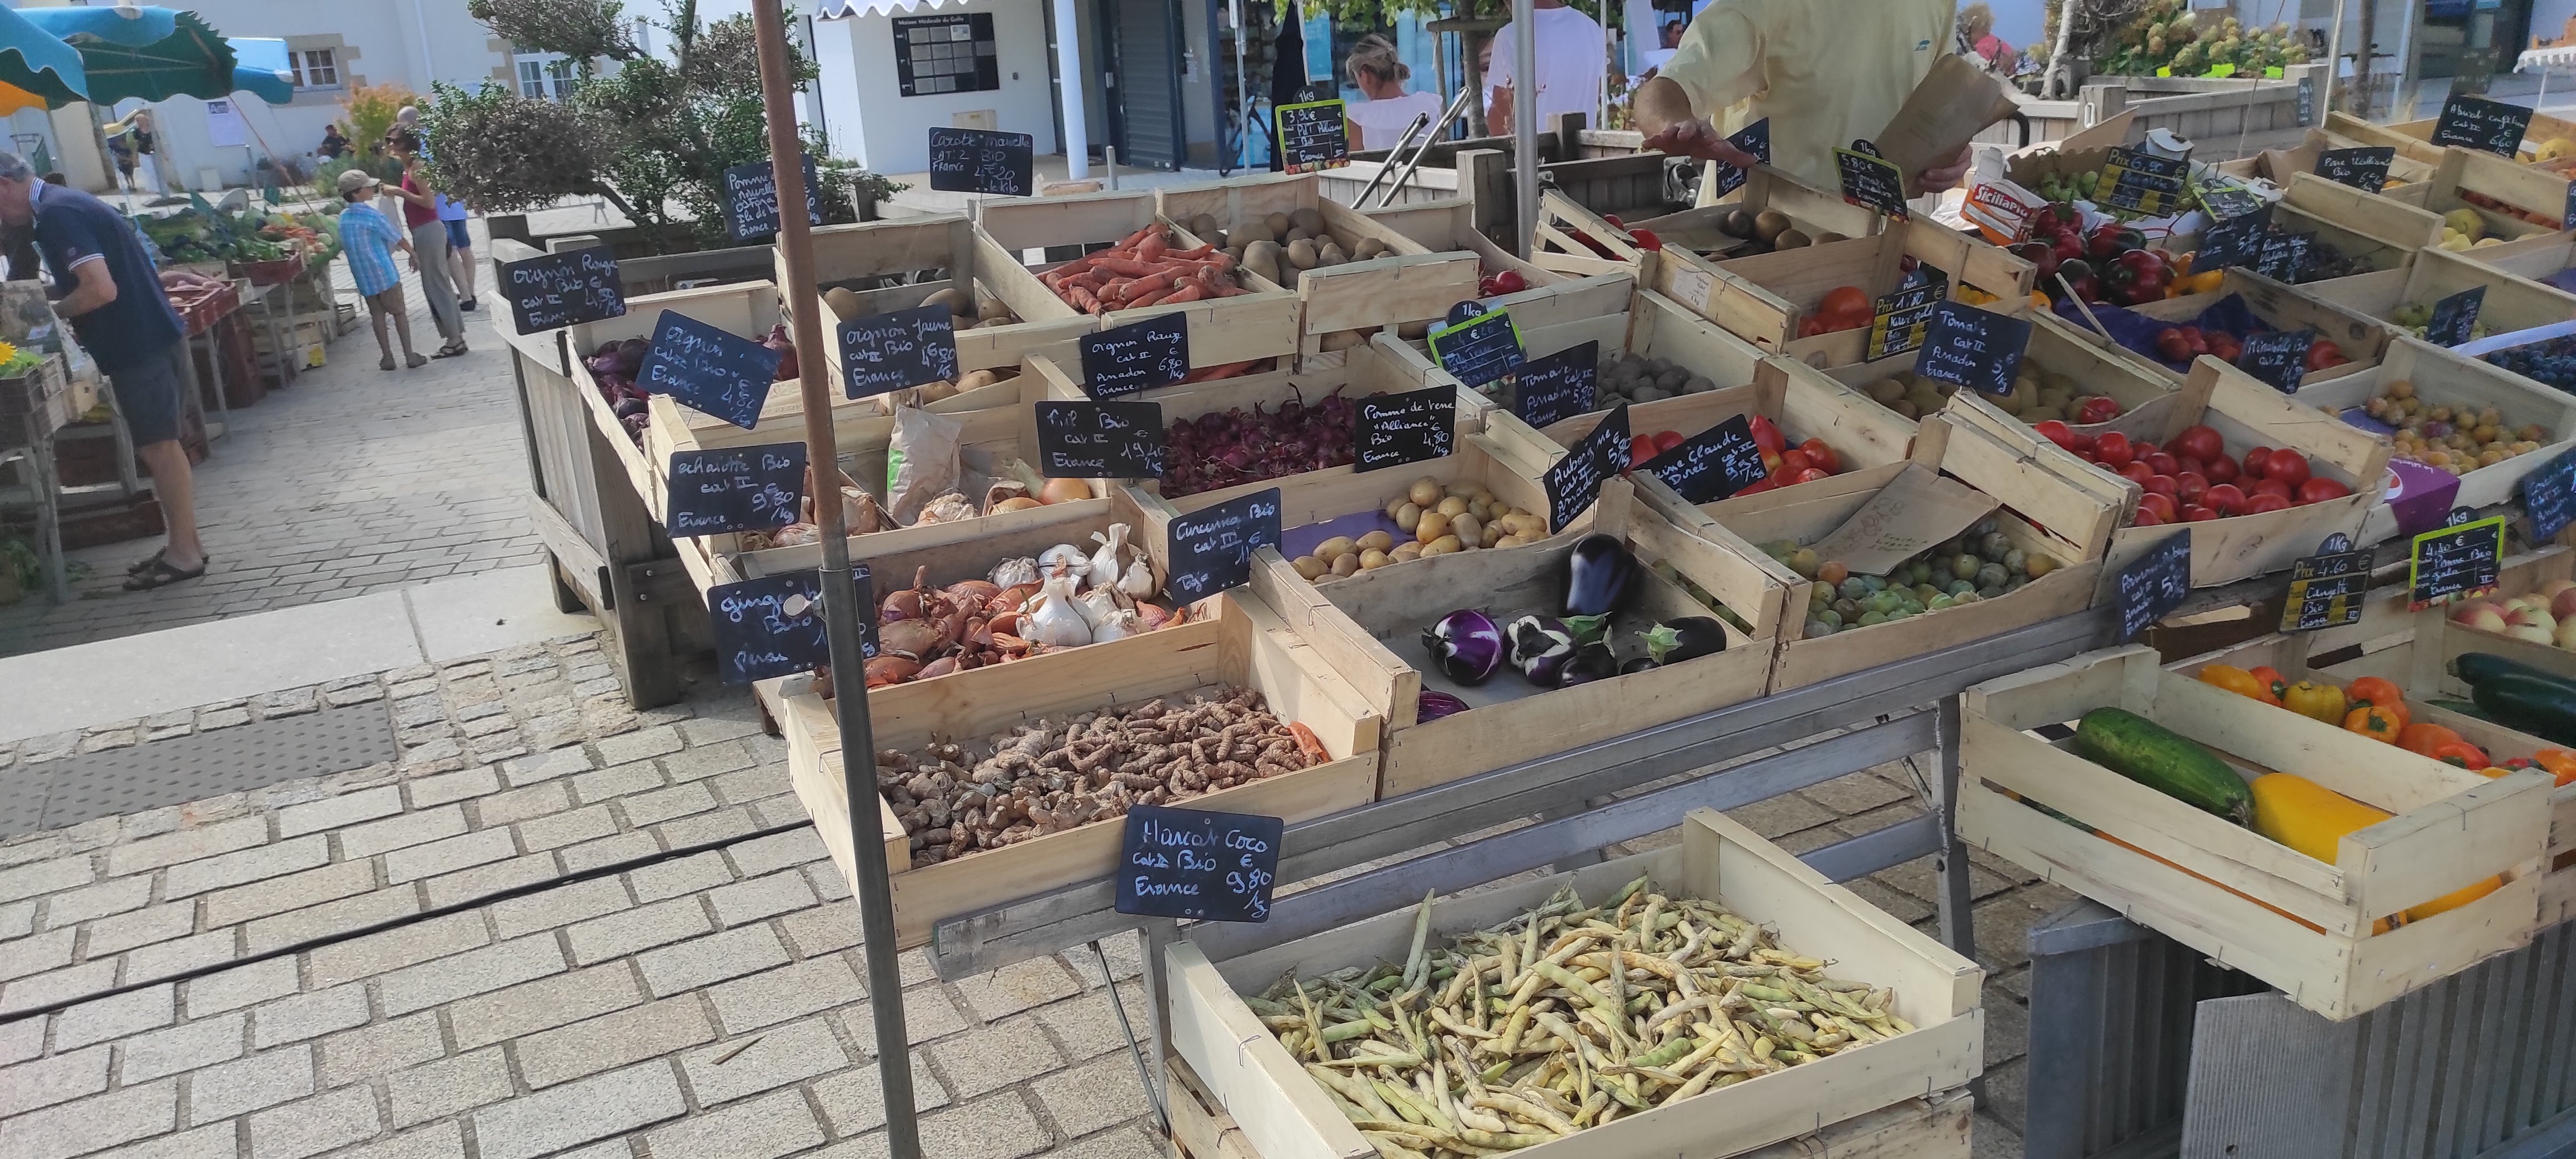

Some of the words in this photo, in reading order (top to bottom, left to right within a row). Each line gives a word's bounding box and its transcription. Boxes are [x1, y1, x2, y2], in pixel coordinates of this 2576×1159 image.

[1299, 89, 1315, 103] 1kg
[884, 340, 914, 356] Bio
[1364, 404, 1406, 420] Pomme
[1410, 401, 1425, 412] de
[1098, 412, 1130, 430] Bio
[1370, 432, 1393, 446] Bio
[762, 453, 791, 471] Bio
[1653, 460, 1686, 480] eine
[1249, 502, 1275, 520] Bio
[2446, 511, 2468, 528] 1kg
[2293, 561, 2315, 580] Prix
[2304, 601, 2323, 614] Bio
[1225, 829, 1269, 853] Coco
[1177, 849, 1217, 872] Bio
[1134, 875, 1200, 897] France
